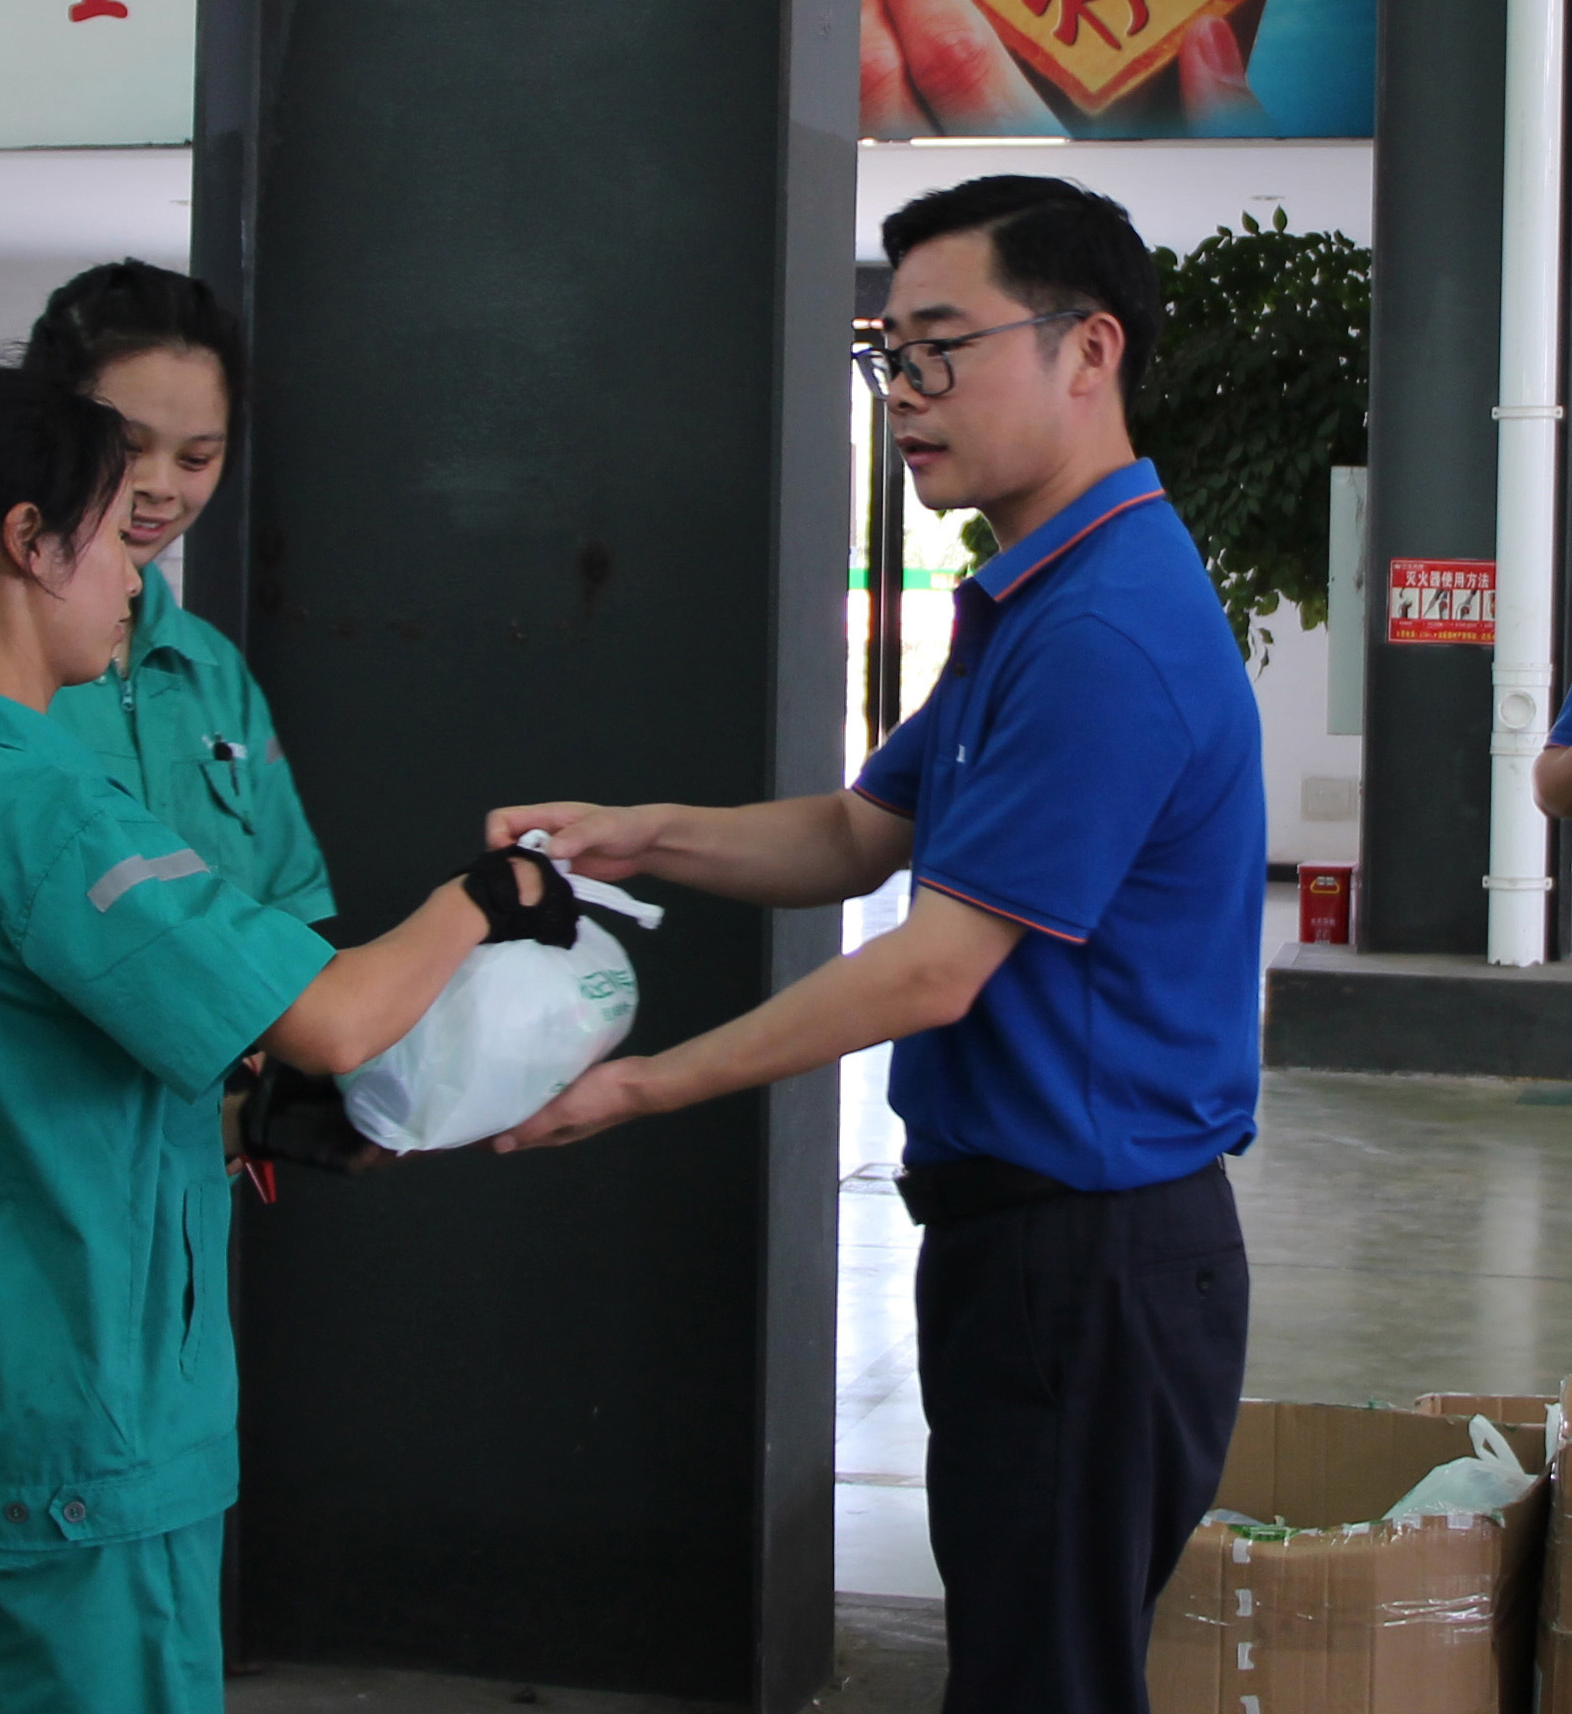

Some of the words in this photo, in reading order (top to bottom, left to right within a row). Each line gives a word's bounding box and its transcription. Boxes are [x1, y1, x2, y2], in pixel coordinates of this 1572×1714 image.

[1405, 570, 1490, 588] 灭火器使用方法
